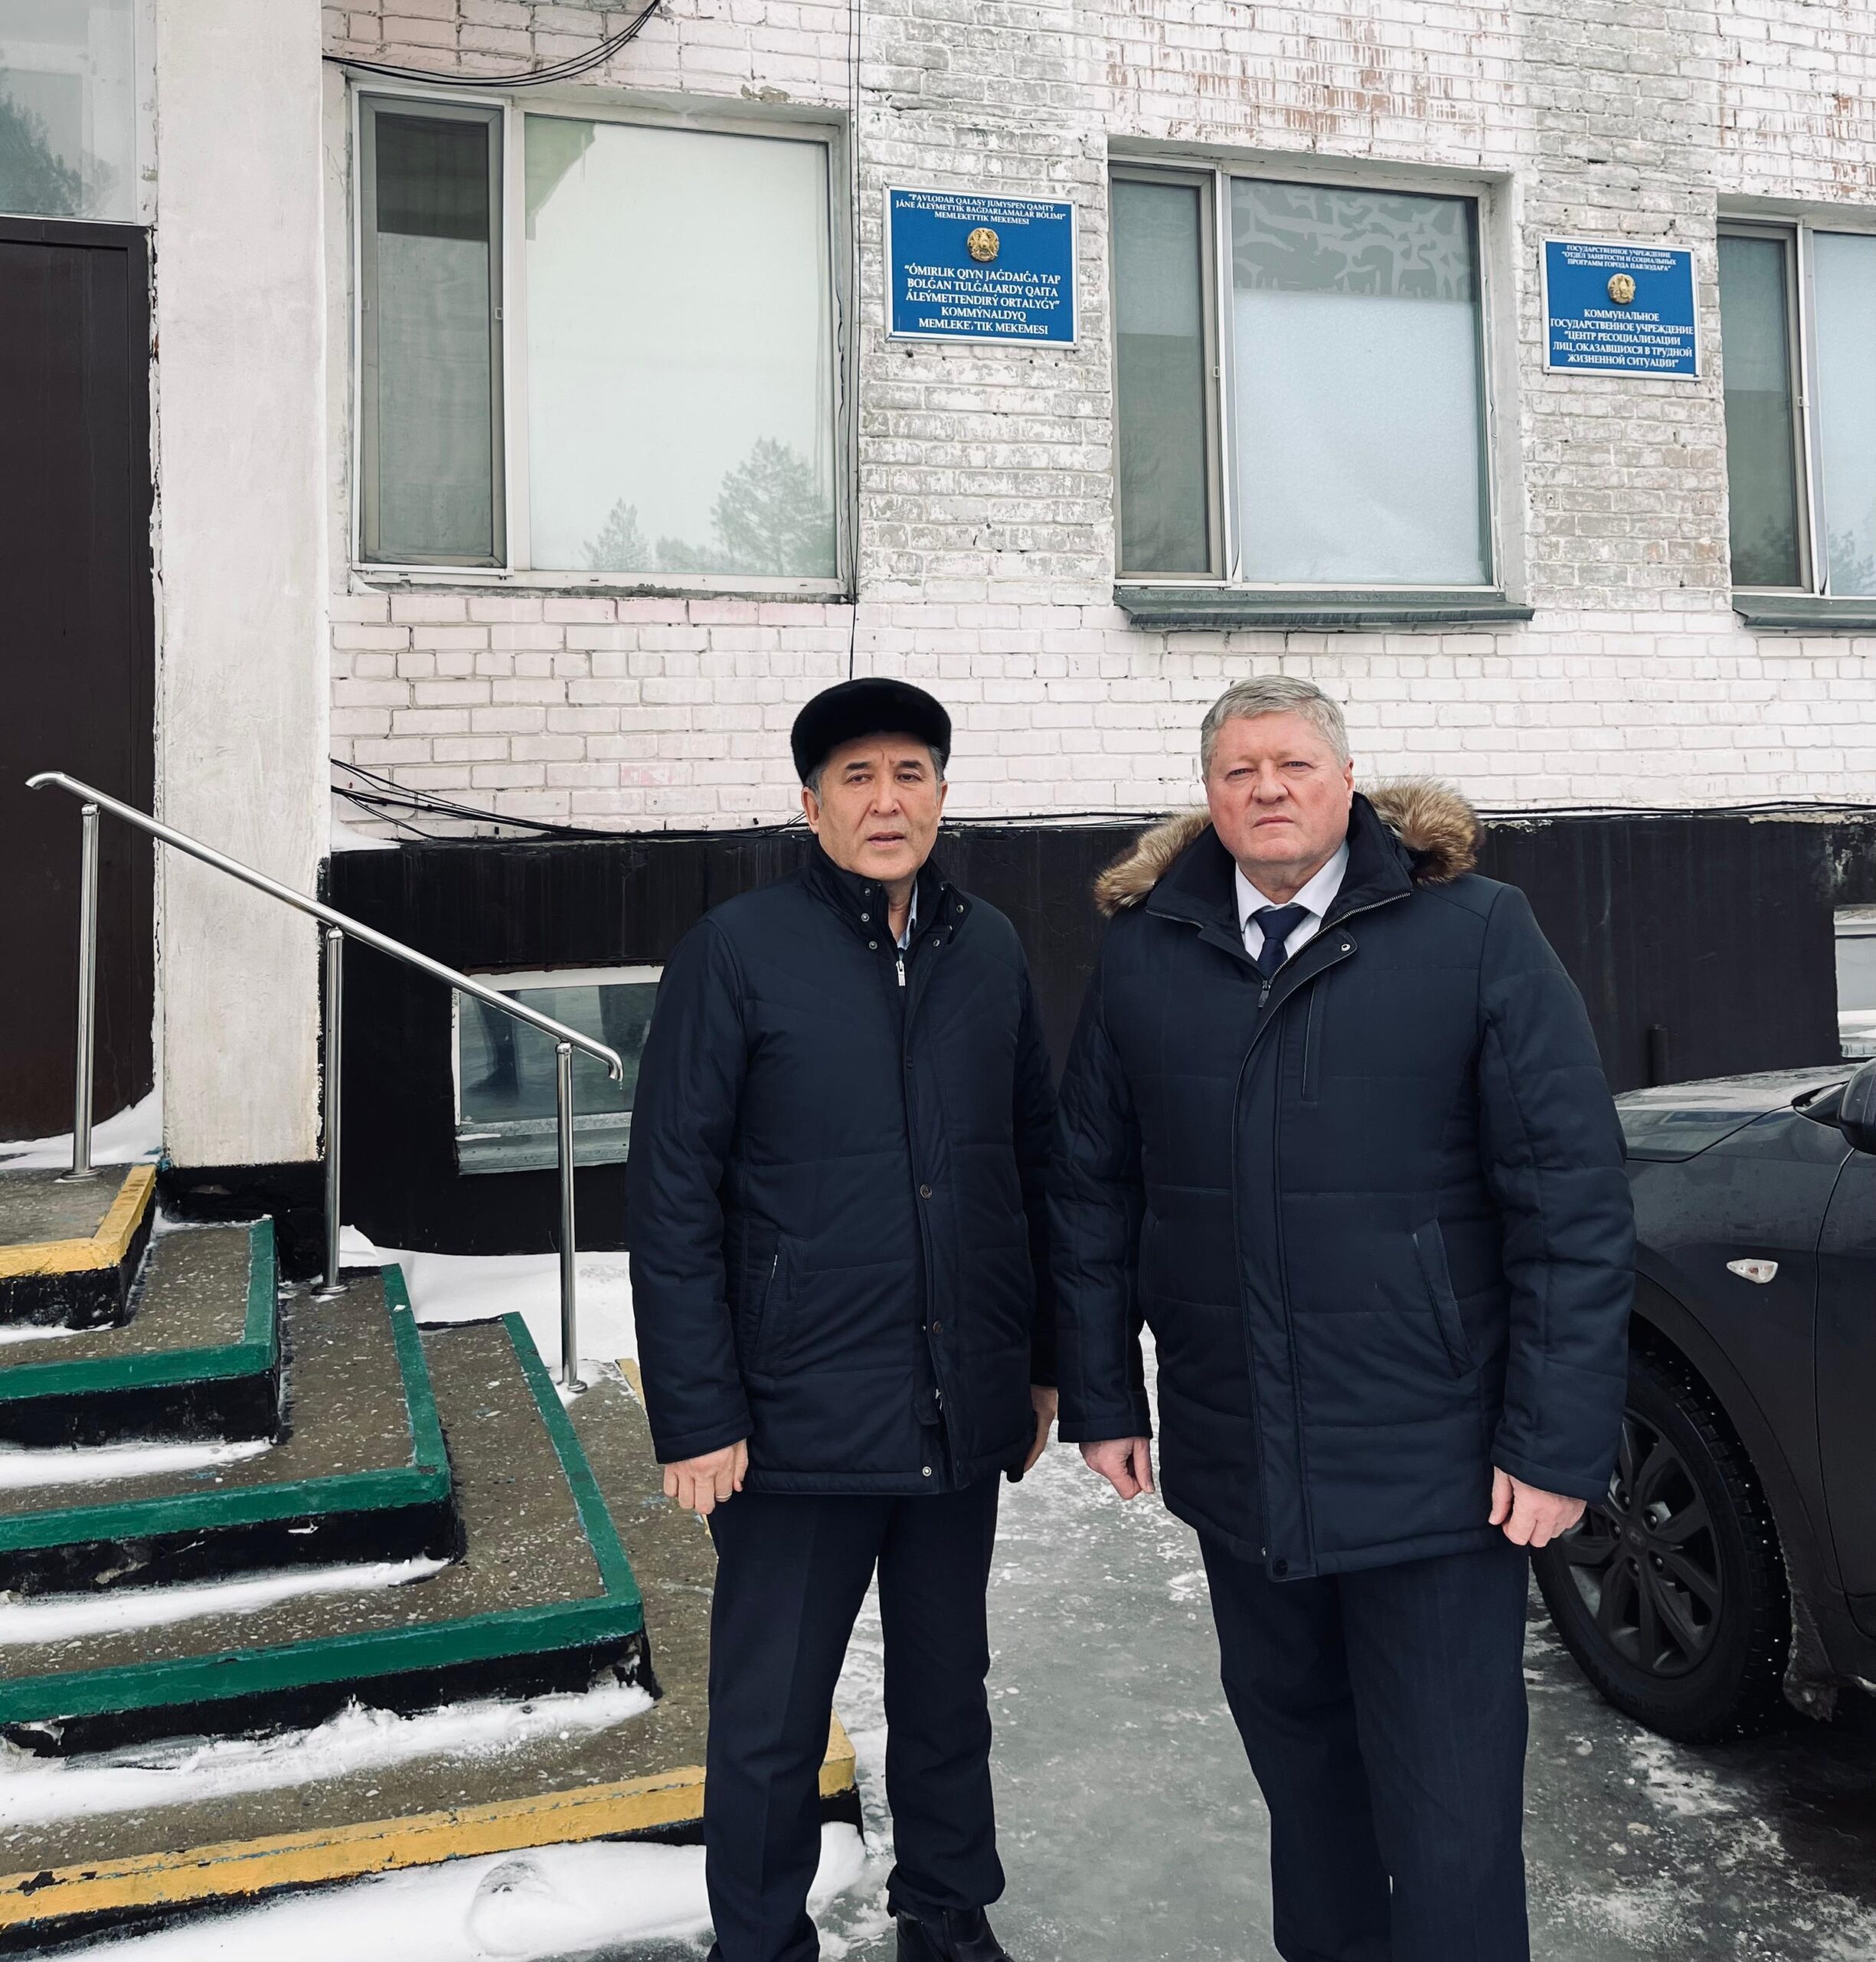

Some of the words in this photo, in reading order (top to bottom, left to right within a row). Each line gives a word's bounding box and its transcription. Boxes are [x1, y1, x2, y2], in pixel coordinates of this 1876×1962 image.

[987, 201, 1025, 210] JUMYSPEN
[935, 212, 989, 221] MEMLEKETTIK
[991, 215, 1029, 225] MEKEMESI
[957, 268, 983, 279] QIYN
[1041, 274, 1061, 284] TAP
[1025, 286, 1058, 297] QAITA
[1584, 309, 1659, 321] КОММУНАЛЬНОЕ
[995, 323, 1048, 334] MEKEMESI
[1550, 318, 1634, 331] ГОСУДАРСТВЕННОЕ
[1636, 324, 1694, 334] УЧРЕЖДЕНИЕ
[1598, 333, 1681, 345] РЕСОЦИАЛИЗАЦИИ
[1645, 346, 1650, 355] В
[1651, 346, 1692, 357] ТРУДНОЙ
[1568, 354, 1625, 364] ЖИЗНЕННОЙ
